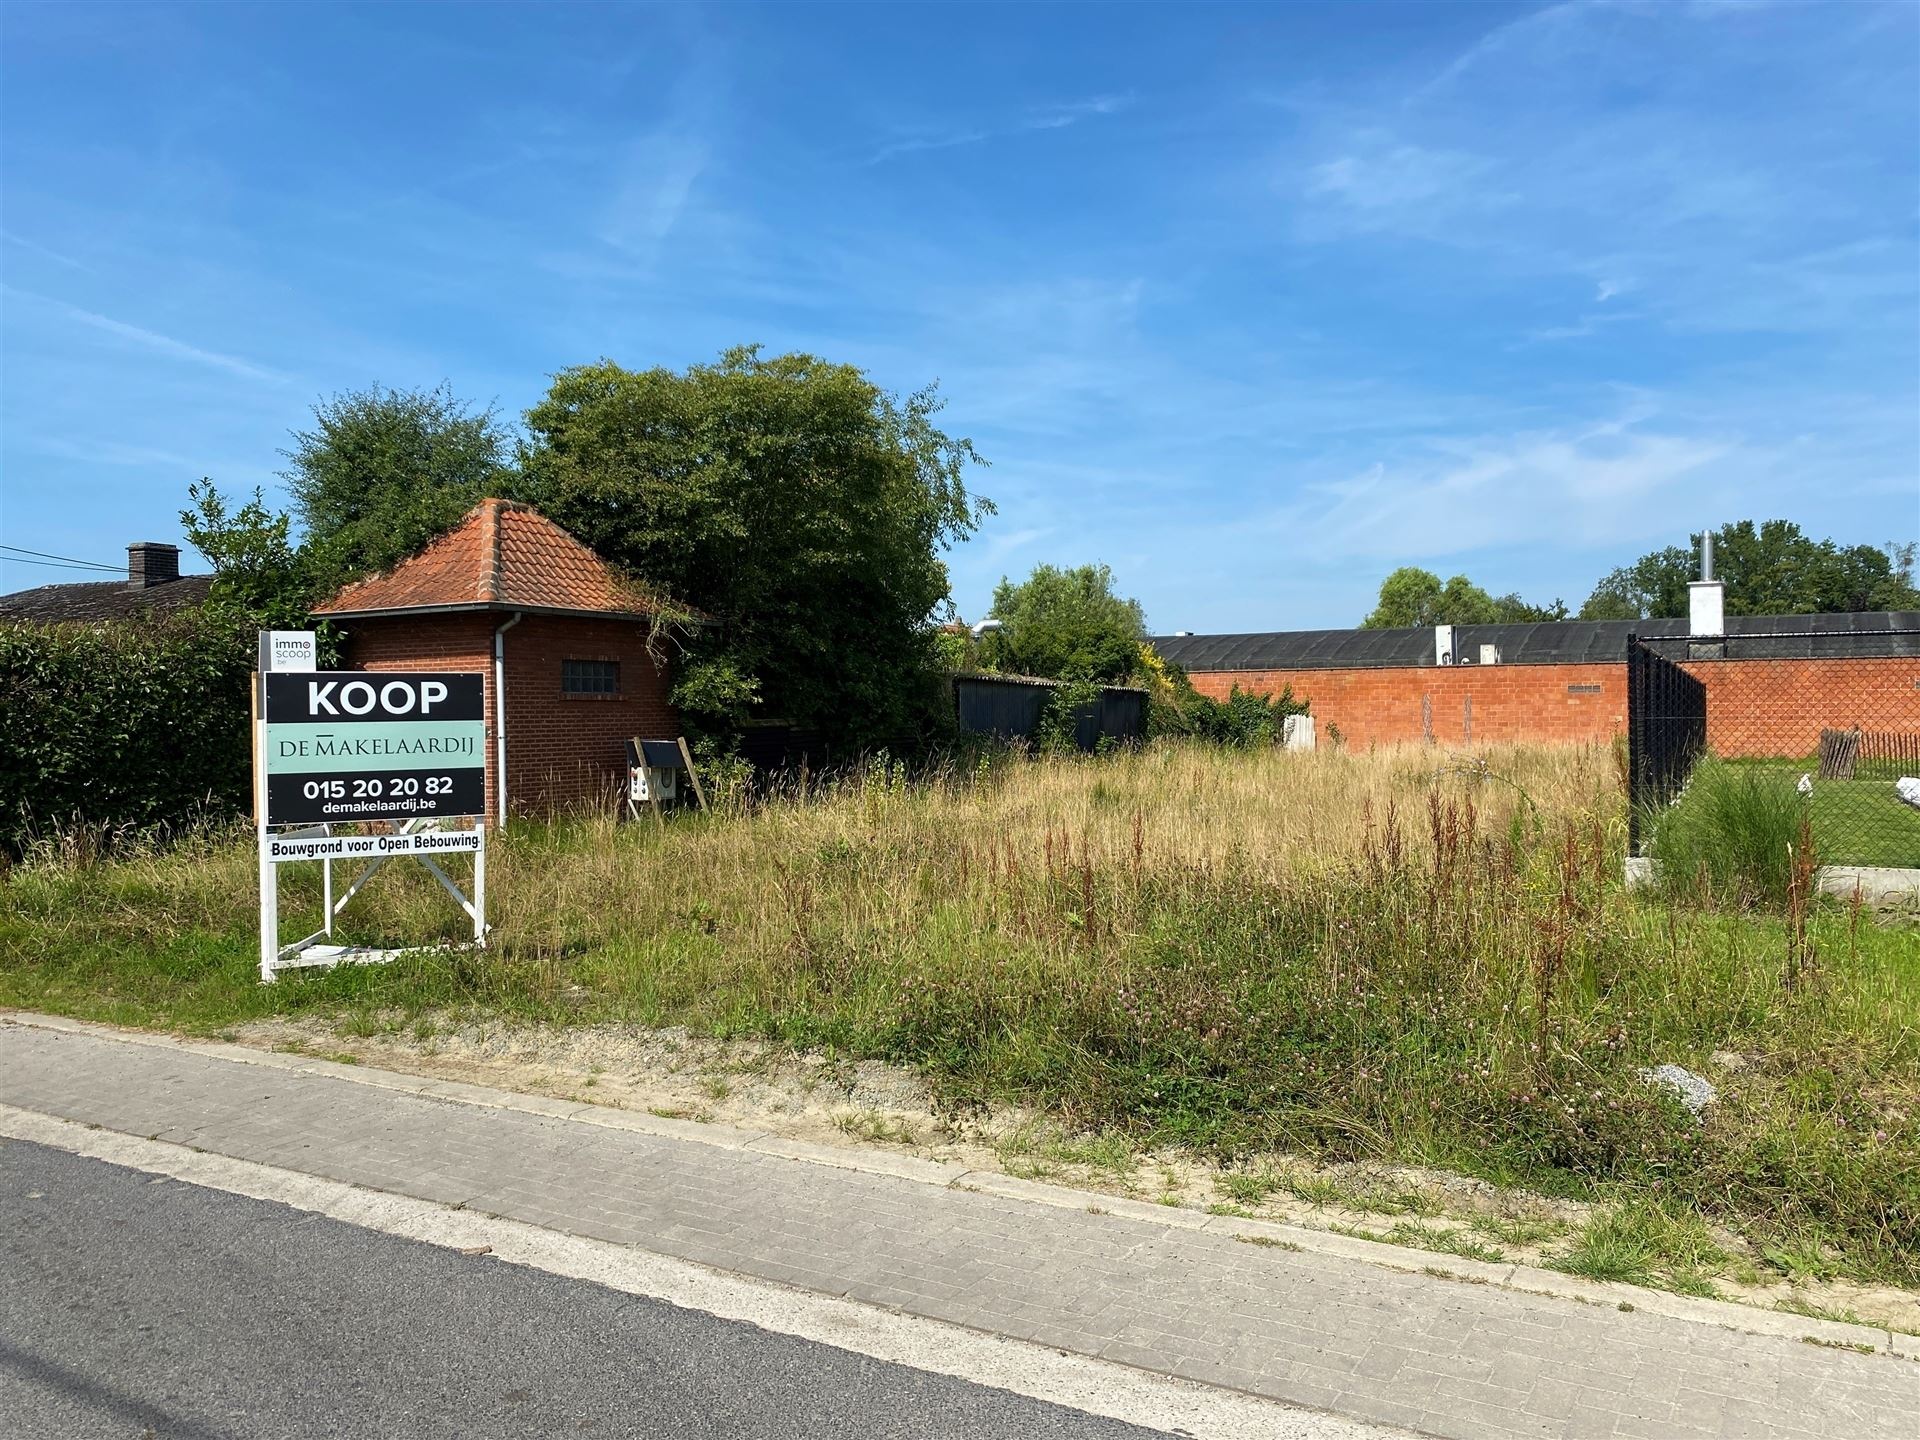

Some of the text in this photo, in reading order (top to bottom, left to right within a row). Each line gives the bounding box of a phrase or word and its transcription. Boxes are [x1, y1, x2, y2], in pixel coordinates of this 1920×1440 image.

[275, 639, 310, 649] immo
[276, 650, 311, 659] scoop
[308, 681, 448, 715] KOOP
[280, 735, 474, 757] DE MAKELAARDIJ
[303, 777, 453, 799] 015 20 20 82
[323, 799, 436, 813] demakelaardij.be
[272, 834, 478, 856] Bouwgrond voor Open Bebouwing
